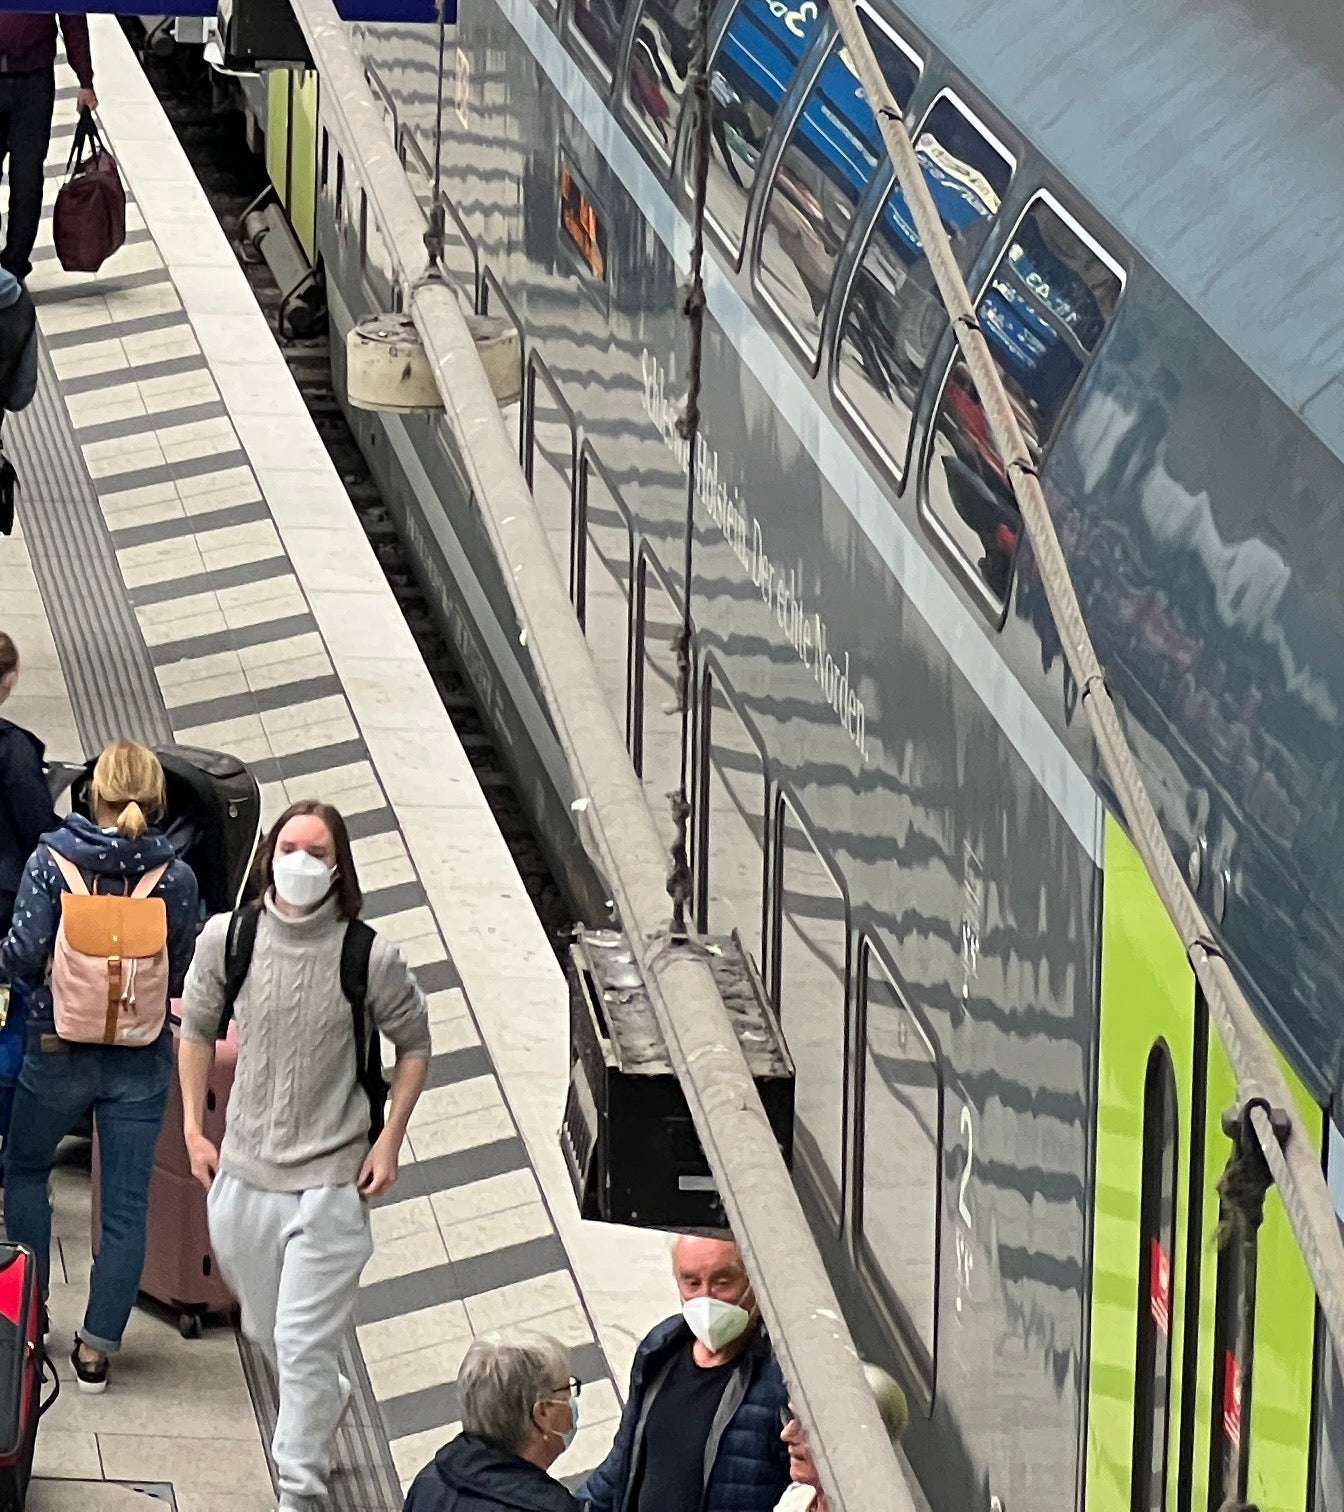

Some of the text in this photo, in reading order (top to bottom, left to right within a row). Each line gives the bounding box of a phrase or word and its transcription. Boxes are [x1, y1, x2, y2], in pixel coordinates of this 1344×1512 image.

[752, 516, 775, 611] Der
[777, 568, 811, 670] echte
[958, 1104, 973, 1229] 2
